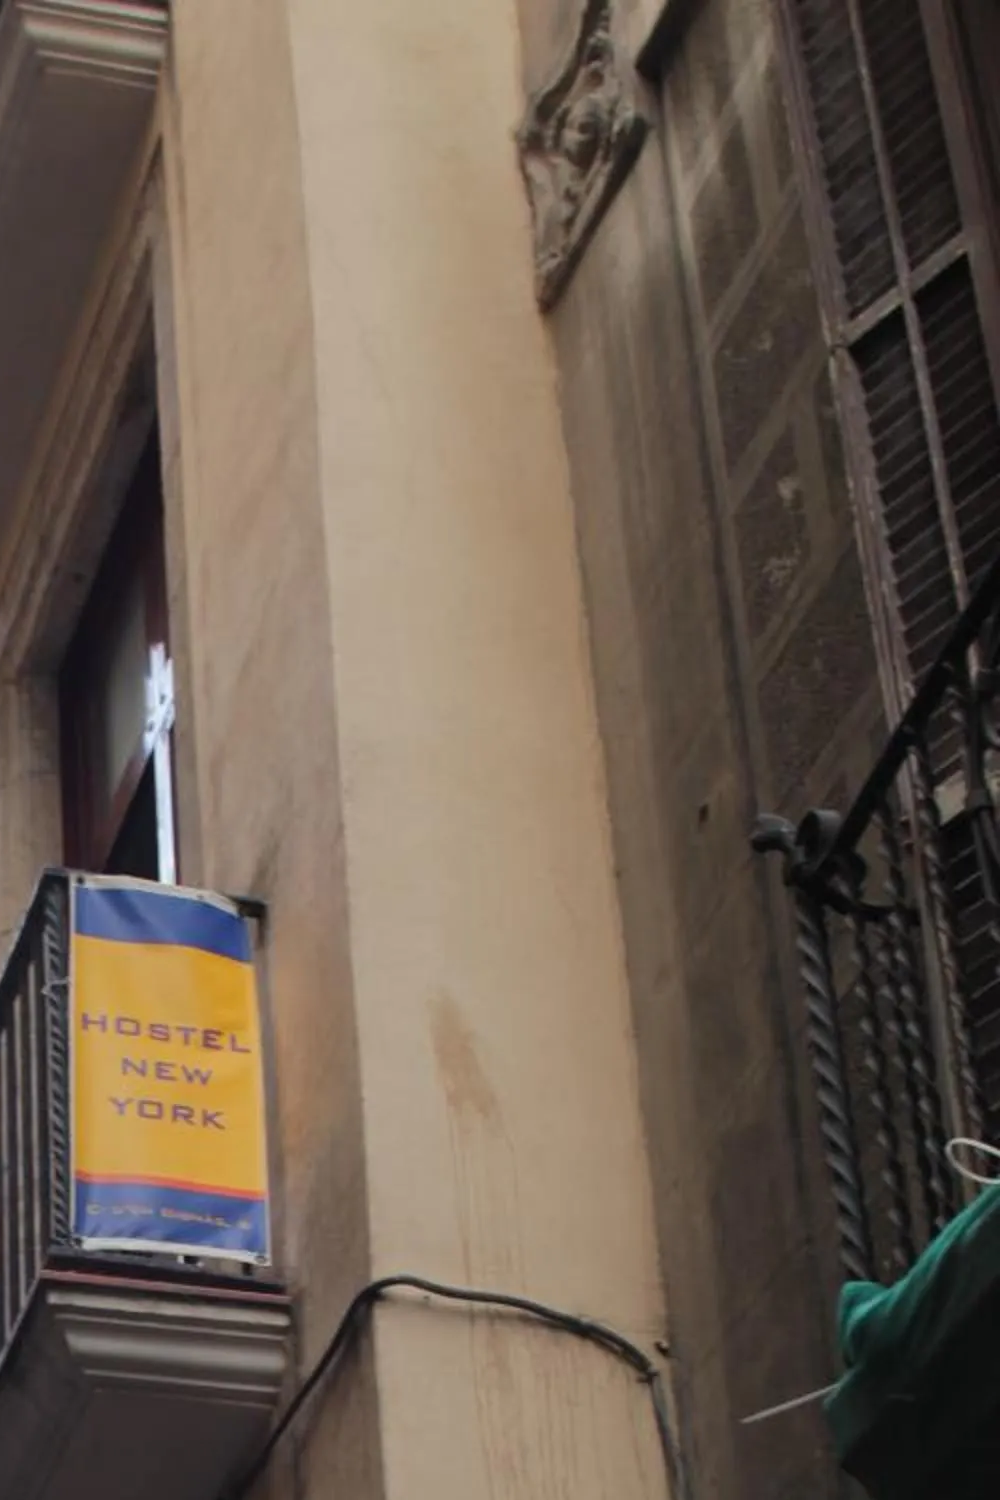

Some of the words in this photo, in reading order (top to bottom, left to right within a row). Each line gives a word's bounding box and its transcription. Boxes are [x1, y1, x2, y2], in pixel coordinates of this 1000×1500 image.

[81, 1012, 252, 1054] HOSTEL
[121, 1057, 213, 1086] NEW
[108, 1097, 226, 1130] YORK
